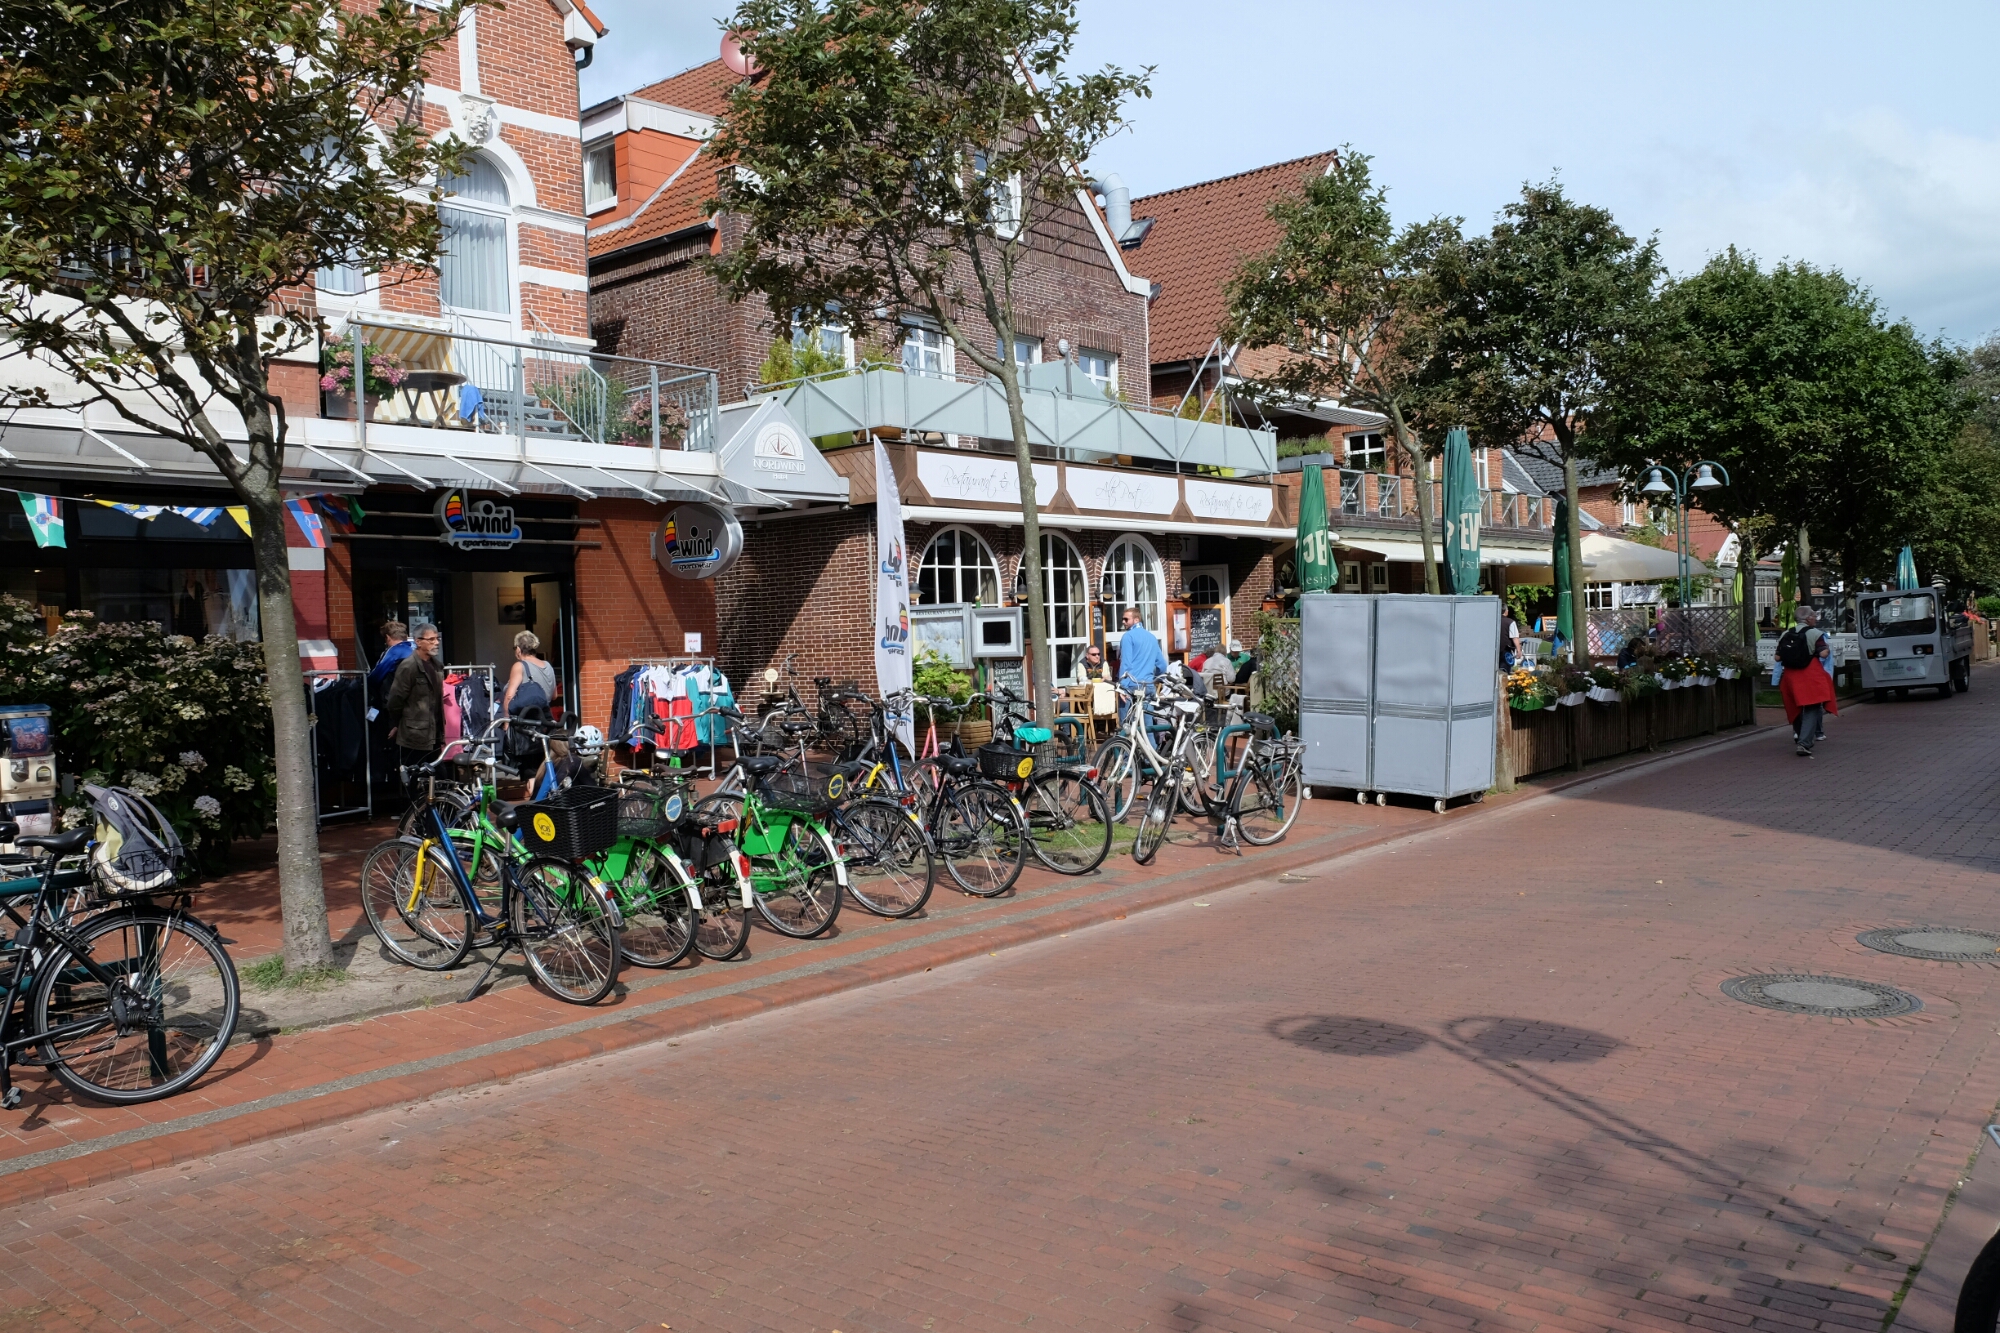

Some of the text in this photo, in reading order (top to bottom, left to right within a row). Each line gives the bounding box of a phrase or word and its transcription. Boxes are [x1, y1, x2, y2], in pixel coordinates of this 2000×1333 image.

[753, 459, 806, 473] NORDWIND
[939, 465, 1010, 498] Restaurant &
[1197, 490, 1236, 516] Restaurant
[467, 503, 512, 533] wind
[462, 540, 511, 548] sportswear
[680, 525, 713, 557] wind
[679, 561, 712, 572] sportswear
